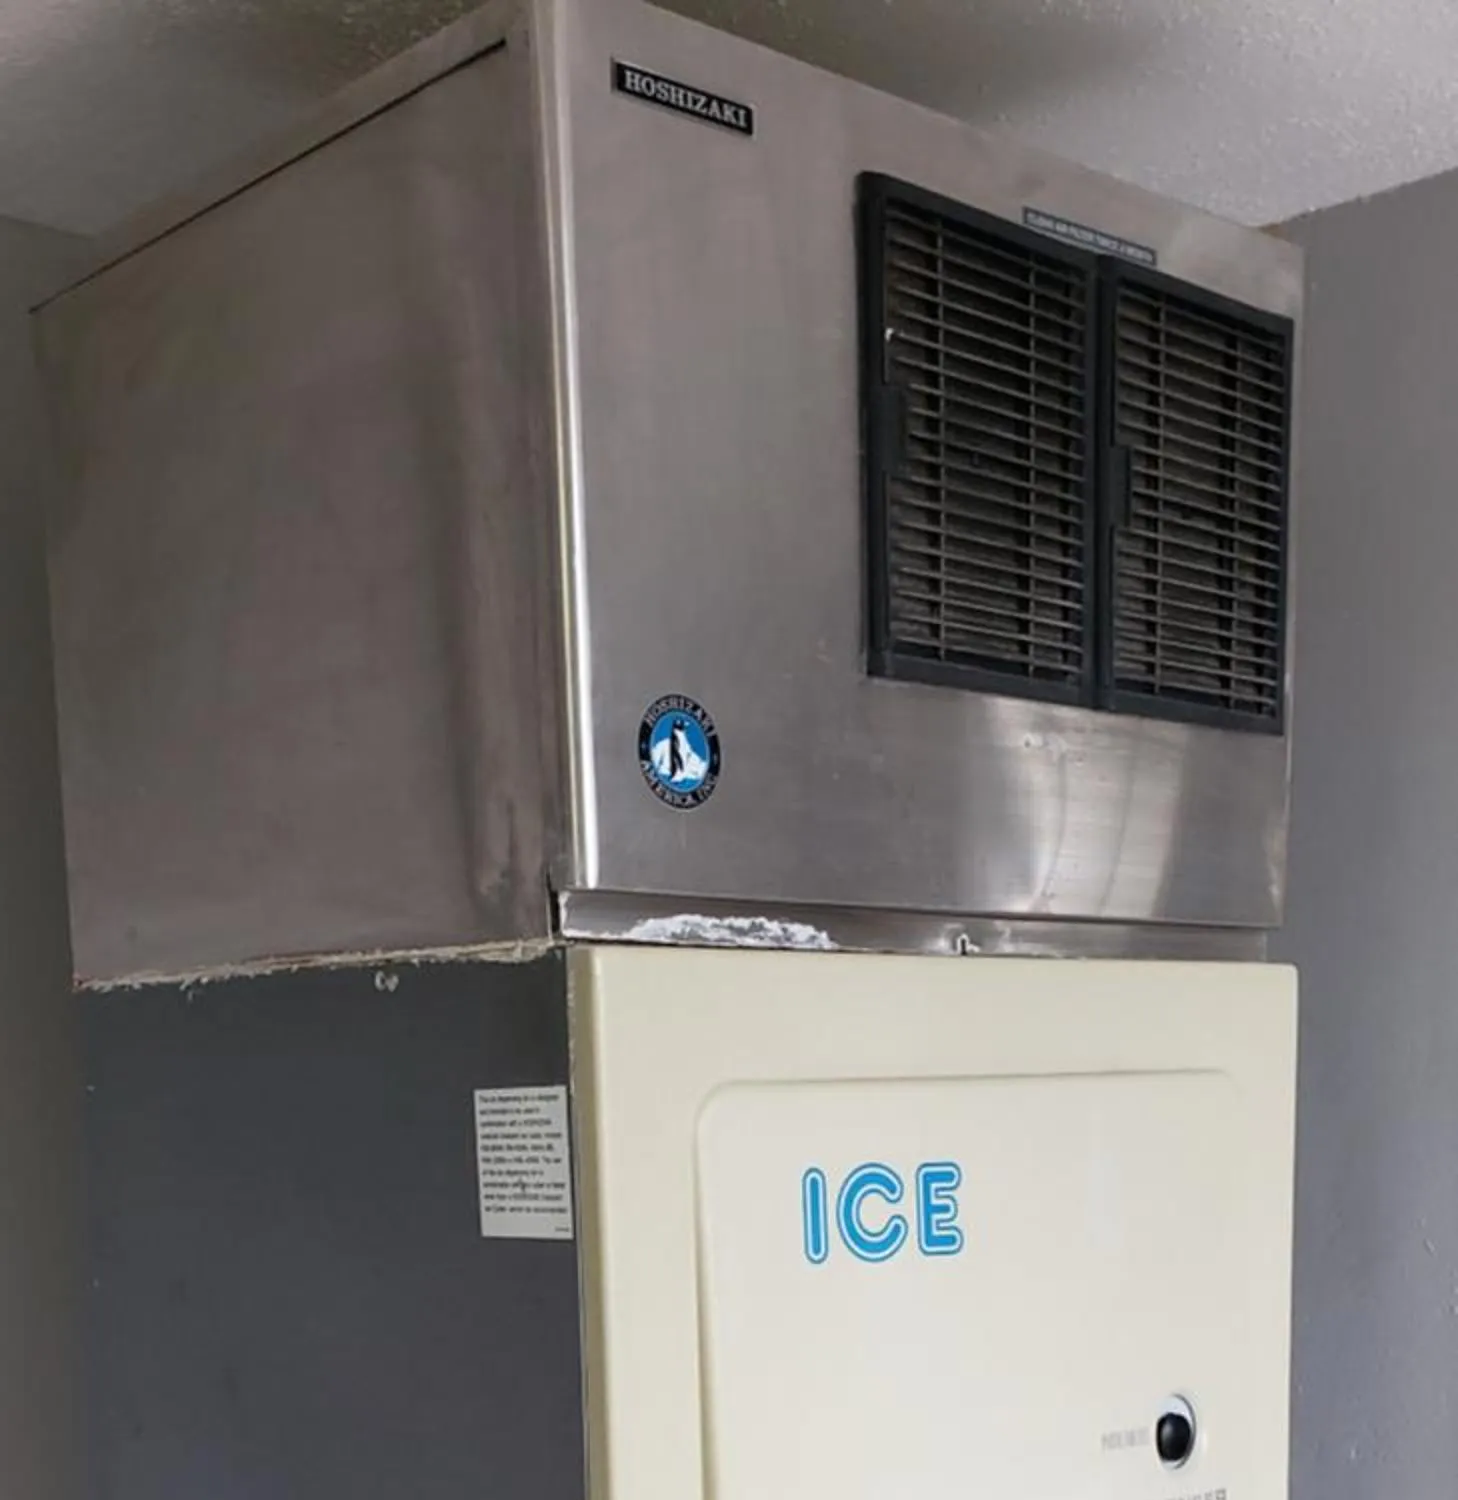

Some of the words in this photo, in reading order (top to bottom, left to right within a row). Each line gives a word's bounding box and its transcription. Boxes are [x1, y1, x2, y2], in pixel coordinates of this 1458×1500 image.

[624, 70, 748, 128] HOSHIZAKI
[645, 697, 717, 737] HOSHIZAKI
[802, 1162, 964, 1265] ICE
